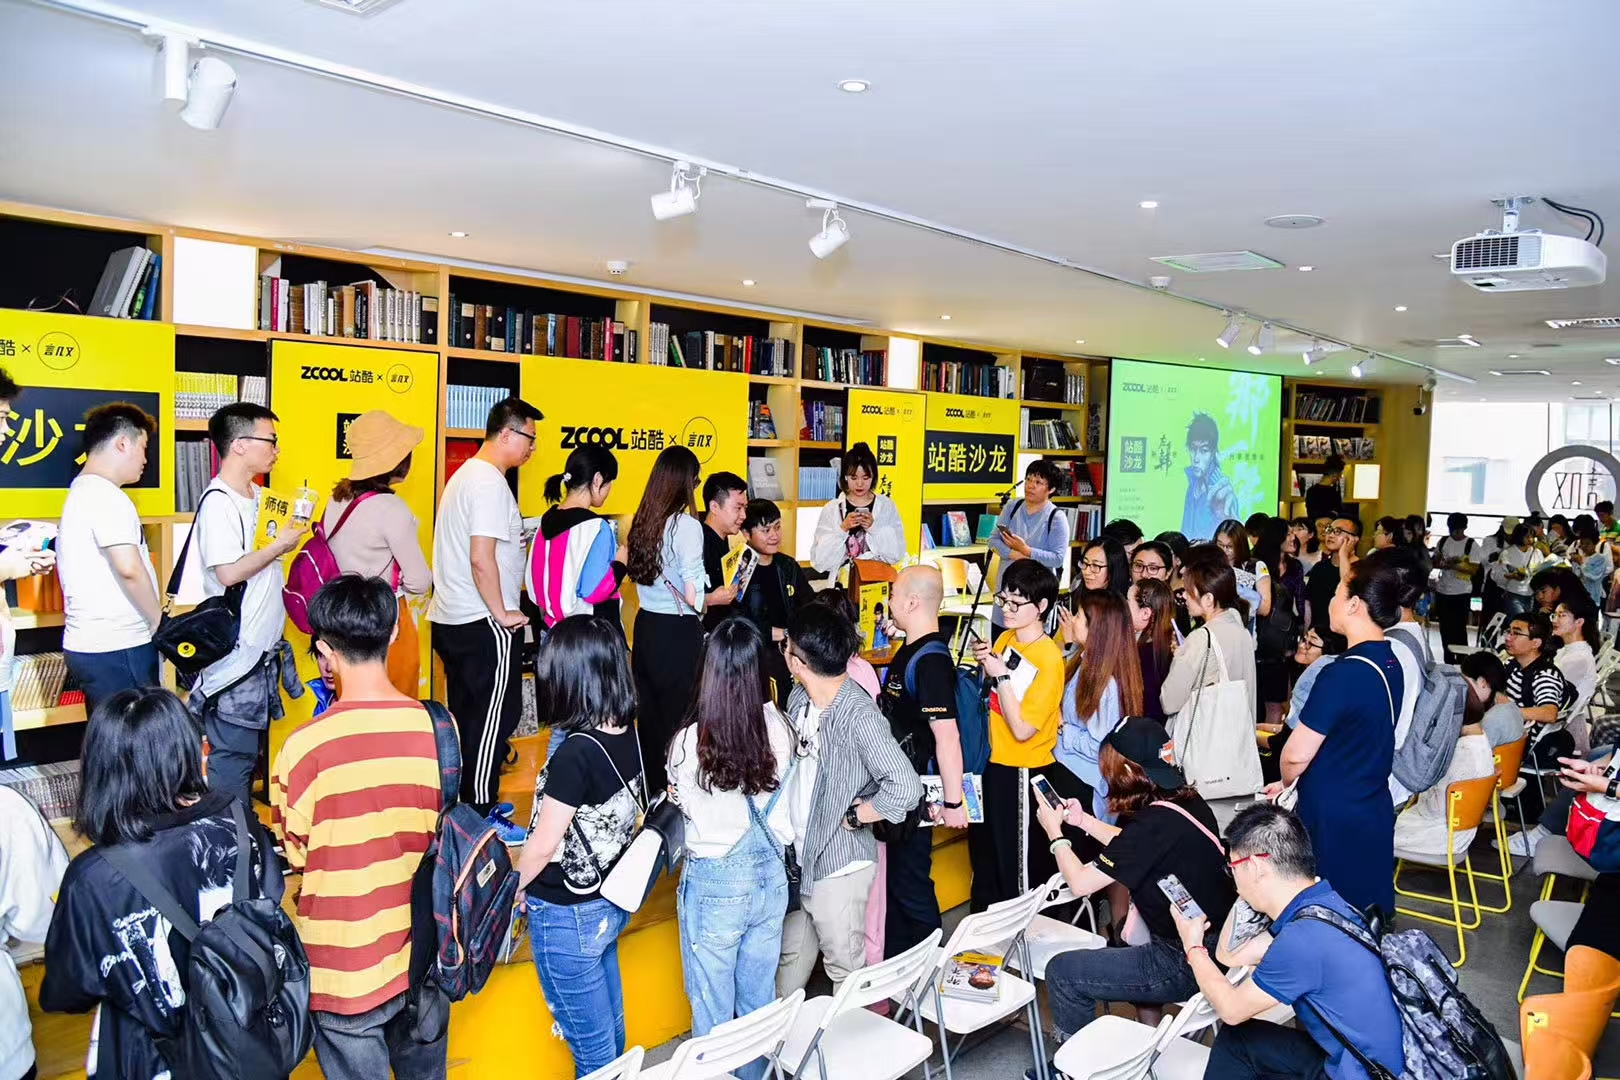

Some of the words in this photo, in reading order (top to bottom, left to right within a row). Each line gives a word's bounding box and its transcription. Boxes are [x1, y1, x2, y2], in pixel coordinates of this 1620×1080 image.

[301, 366, 348, 382] ZCOOL
[350, 369, 374, 384] 站酷
[861, 405, 883, 415] ZCOOL
[945, 408, 965, 418] ZCOOL
[560, 426, 629, 450] ZCOOL
[631, 429, 664, 450] 站酷
[928, 441, 1007, 473] 站酷沙龙
